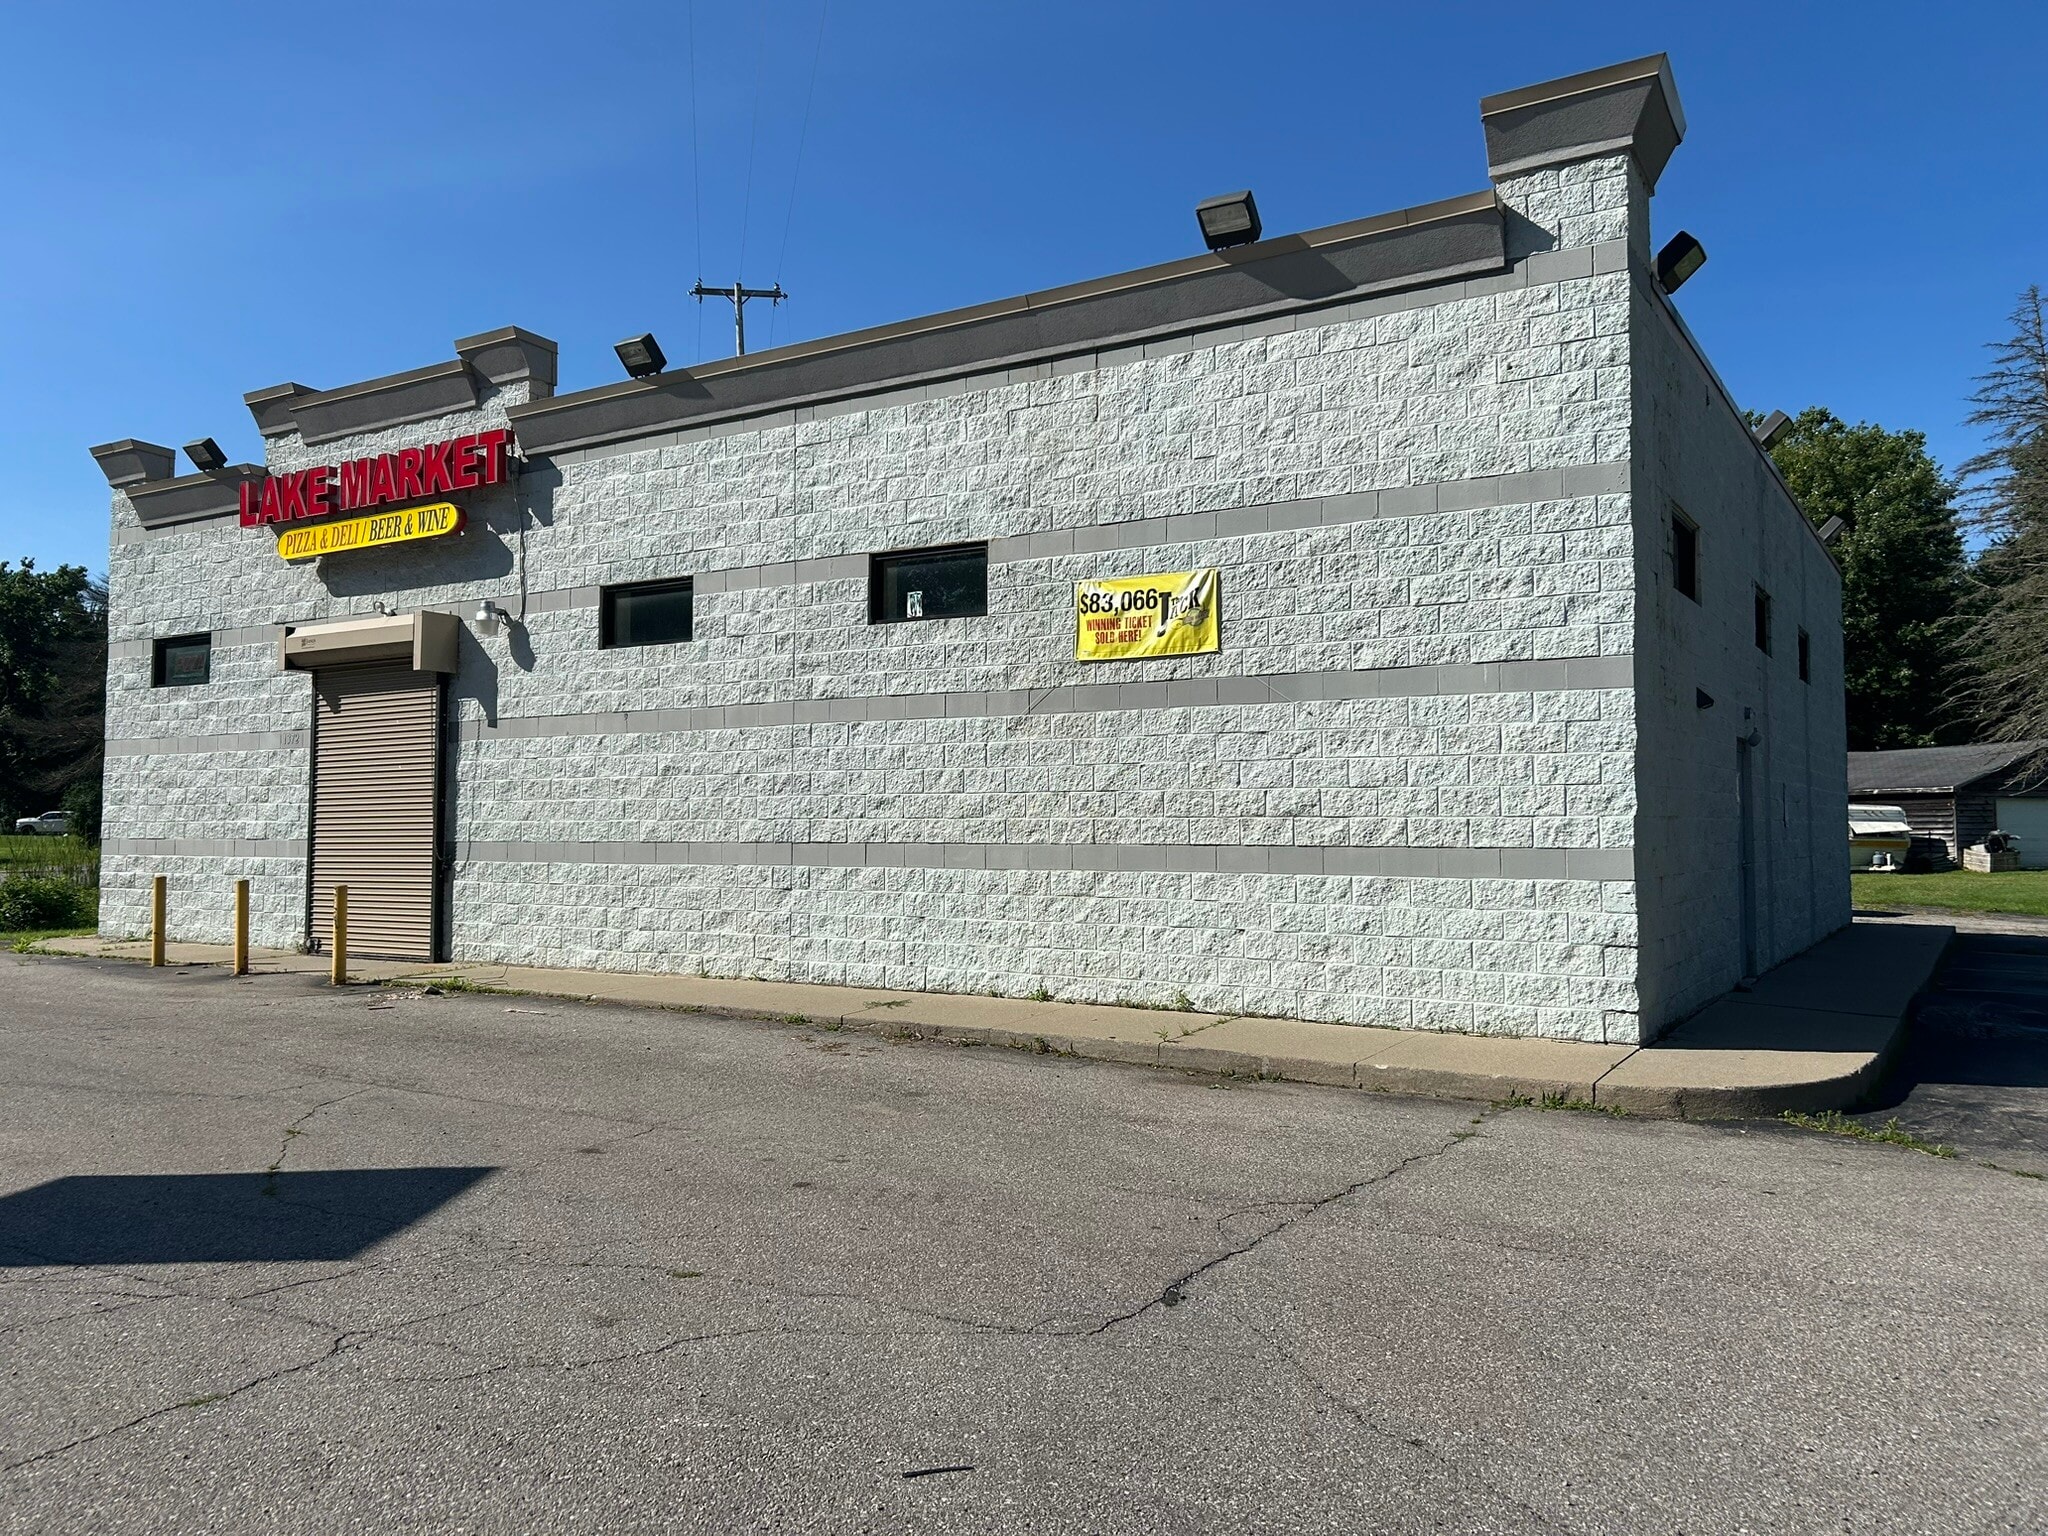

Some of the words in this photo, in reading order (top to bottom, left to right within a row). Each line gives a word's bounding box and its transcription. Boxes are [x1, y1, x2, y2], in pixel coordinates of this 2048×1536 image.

[240, 465, 337, 527] LAKE
[340, 428, 512, 510] MARKET
[285, 530, 317, 556] PIZZA
[320, 529, 328, 550] &
[331, 522, 360, 547] DELI
[361, 521, 367, 543] /
[369, 516, 402, 542] BEER
[404, 515, 412, 535] &
[418, 506, 450, 533] WINE
[1080, 588, 1158, 616] $83,066
[1086, 617, 1121, 632] WINNING
[1125, 615, 1153, 629] TICKET
[1095, 630, 1115, 645] SOLD
[1118, 629, 1142, 643] HERE!
